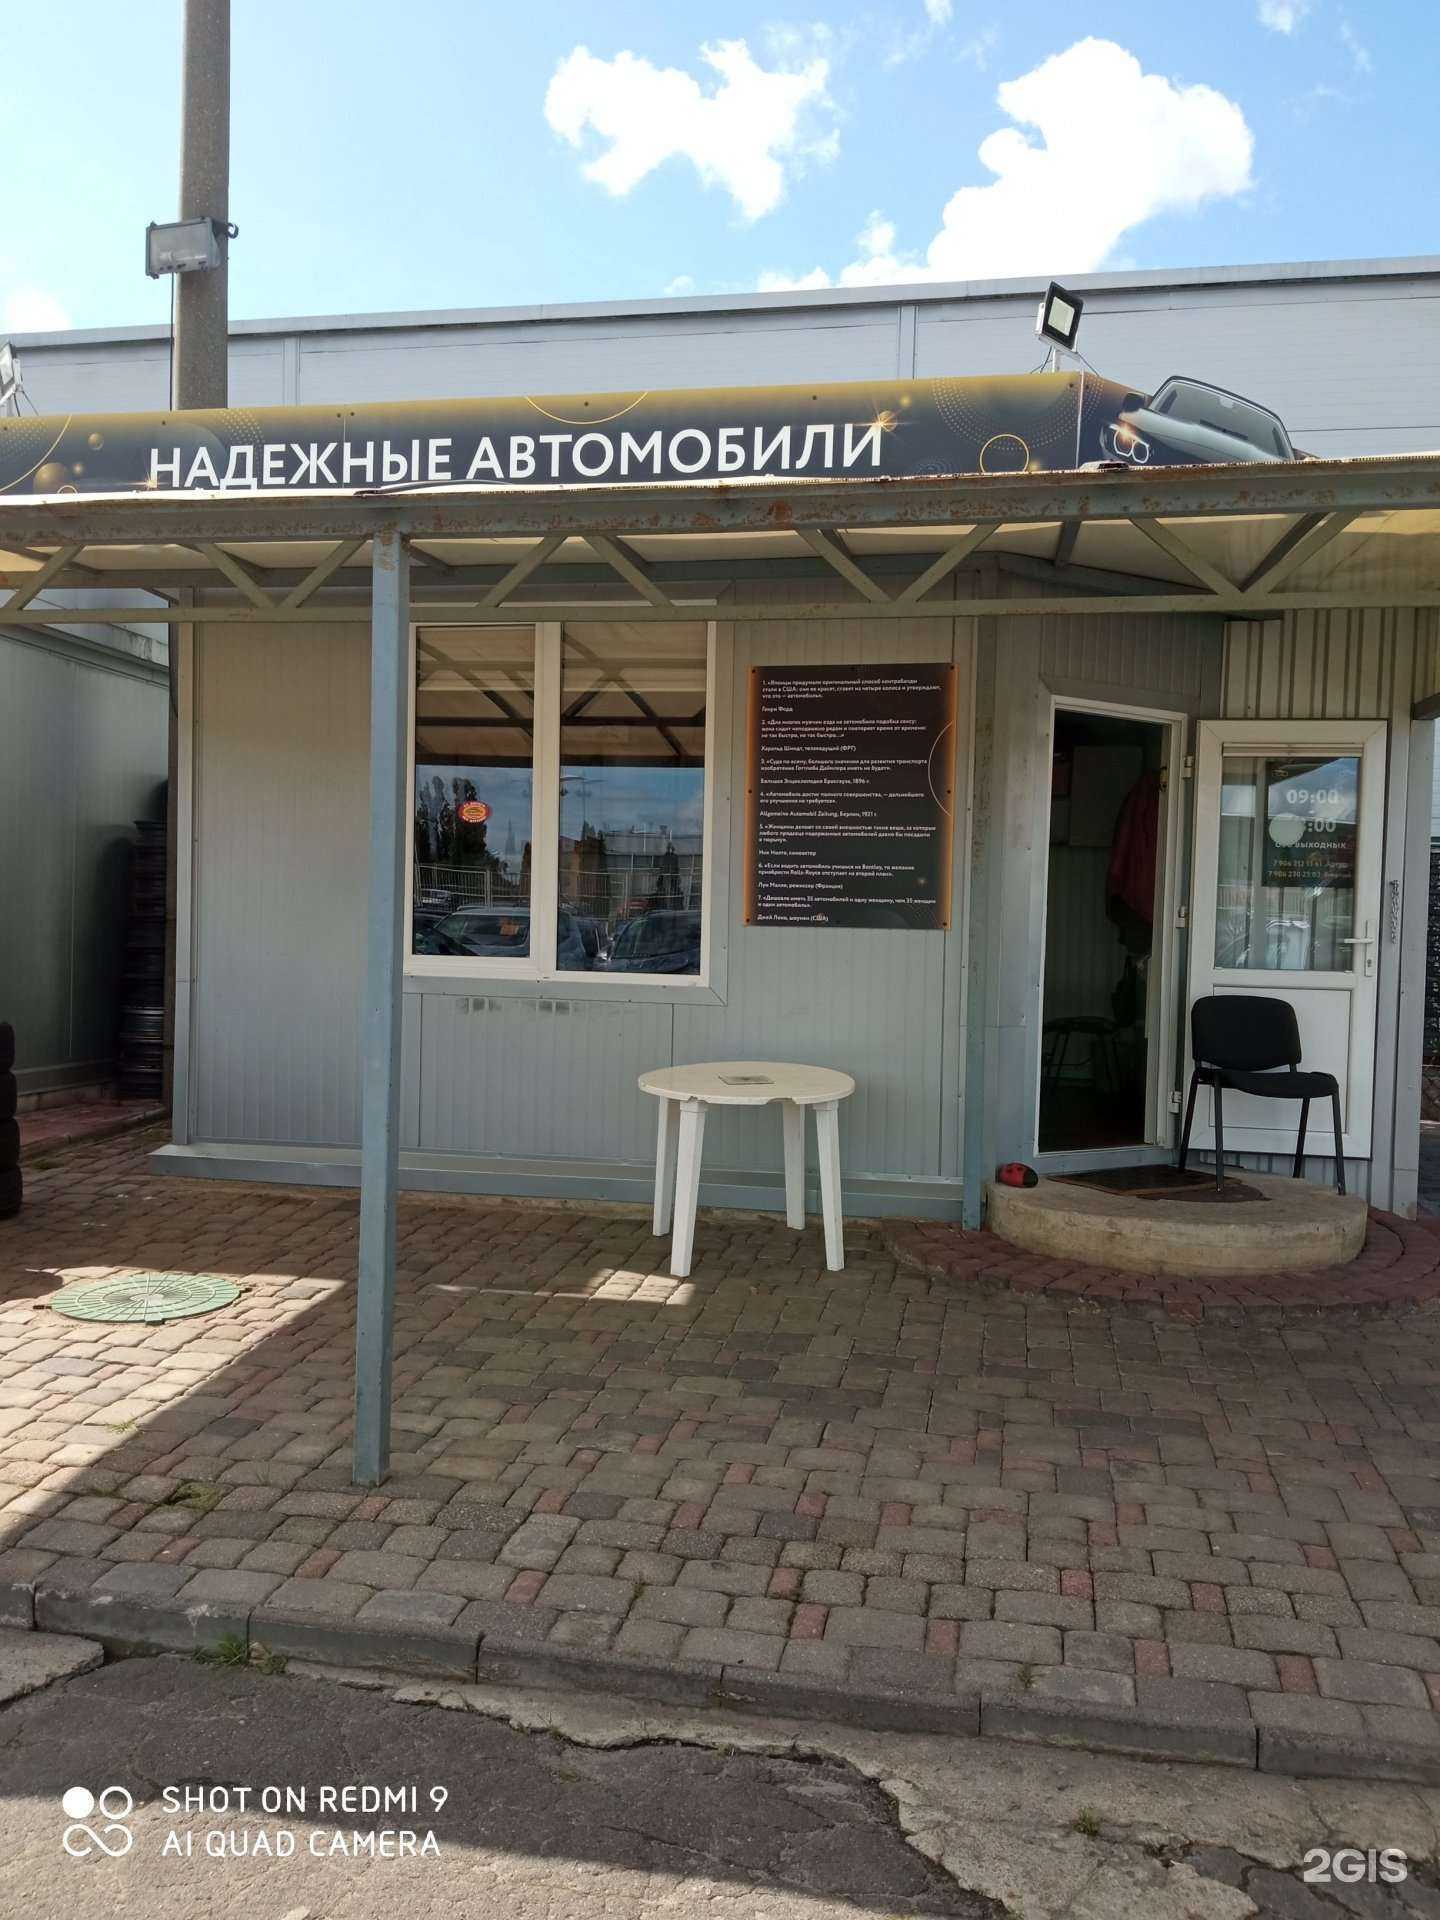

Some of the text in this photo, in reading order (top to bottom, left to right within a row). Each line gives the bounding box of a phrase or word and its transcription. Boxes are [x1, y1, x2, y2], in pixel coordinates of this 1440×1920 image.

[150, 423, 882, 490] НАДЕЖНЫЕ АВТОМОБИЛИ
[1286, 789, 1339, 804] 09:00
